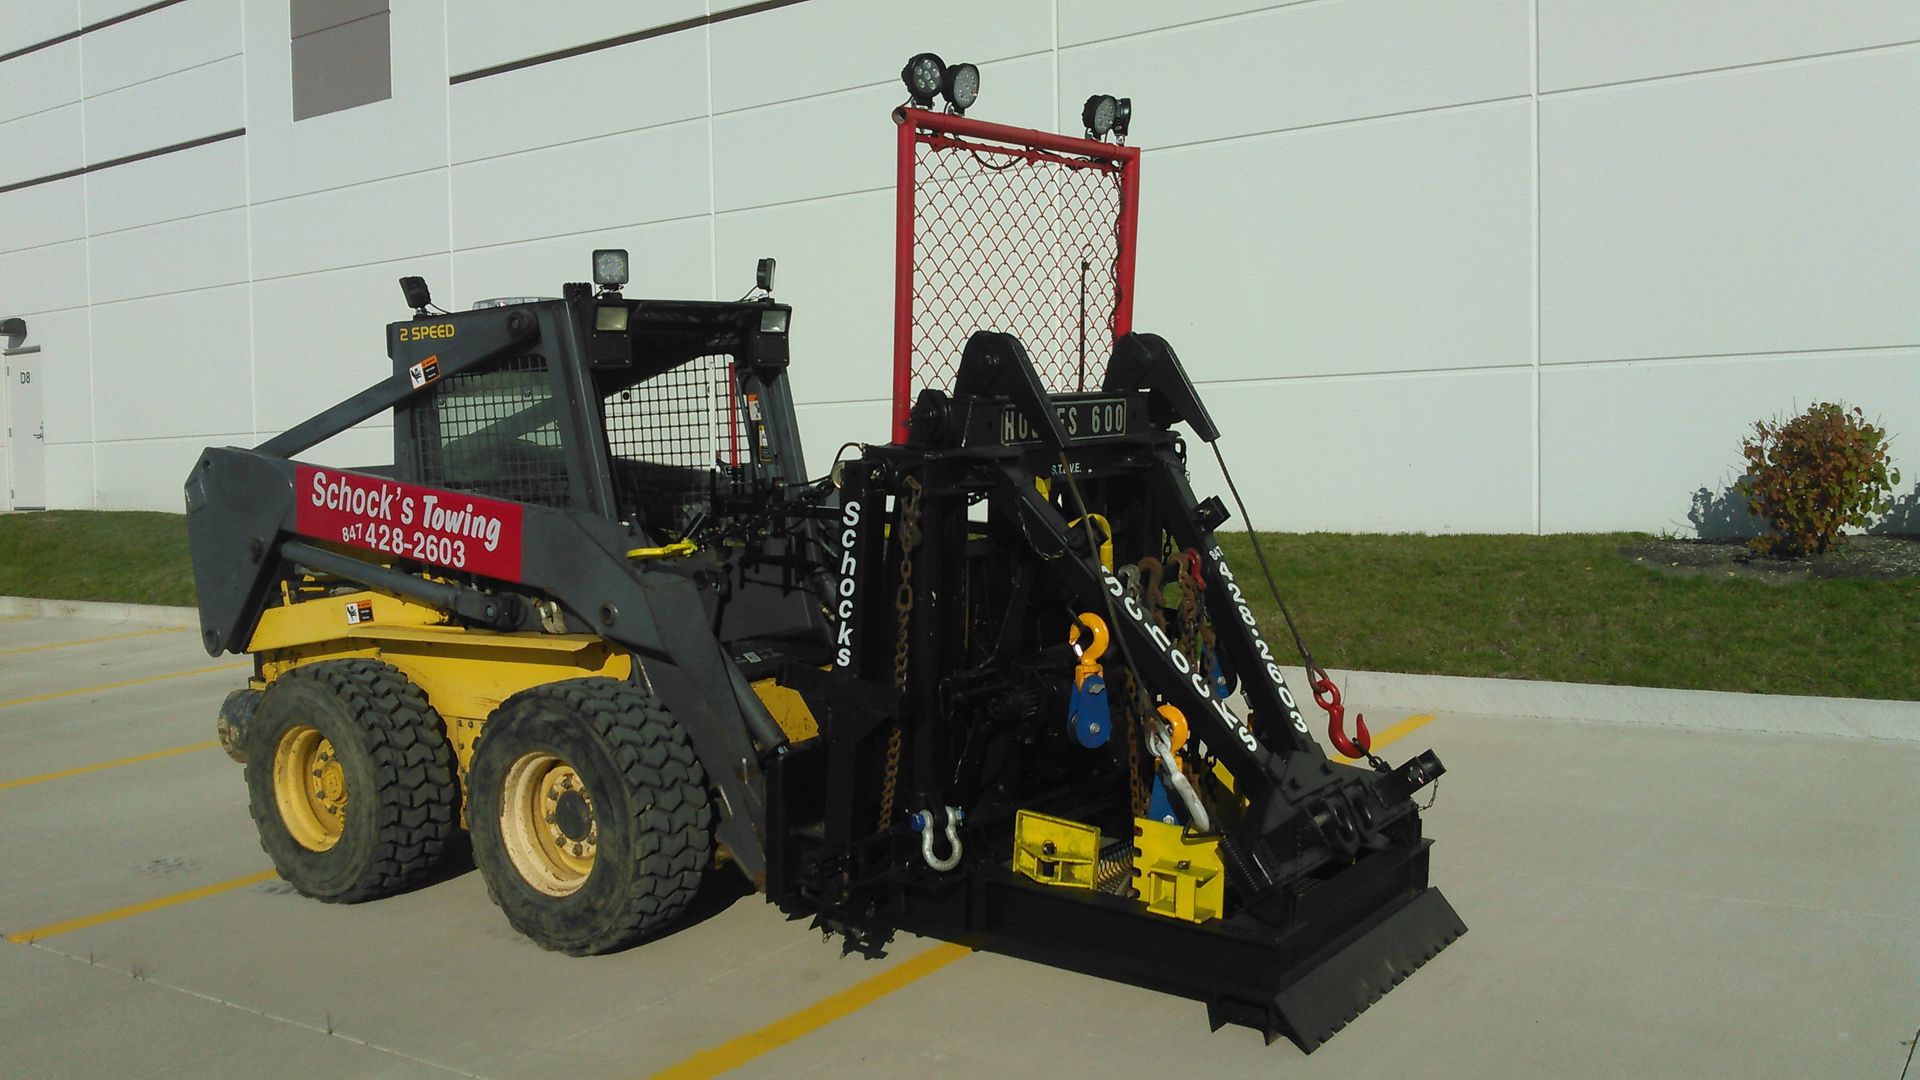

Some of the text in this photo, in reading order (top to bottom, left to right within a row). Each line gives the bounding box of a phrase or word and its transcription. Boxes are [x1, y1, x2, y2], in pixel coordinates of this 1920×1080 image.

[399, 323, 455, 341] 2 SPEED
[20, 371, 31, 384] D8
[1004, 404, 1124, 440] HOS 600
[311, 471, 501, 552] Schock's Towing
[341, 522, 466, 568] 847 428-2603
[1208, 545, 1225, 562] 847
[836, 501, 861, 667] Schocks
[1101, 565, 1258, 752] Schocks
